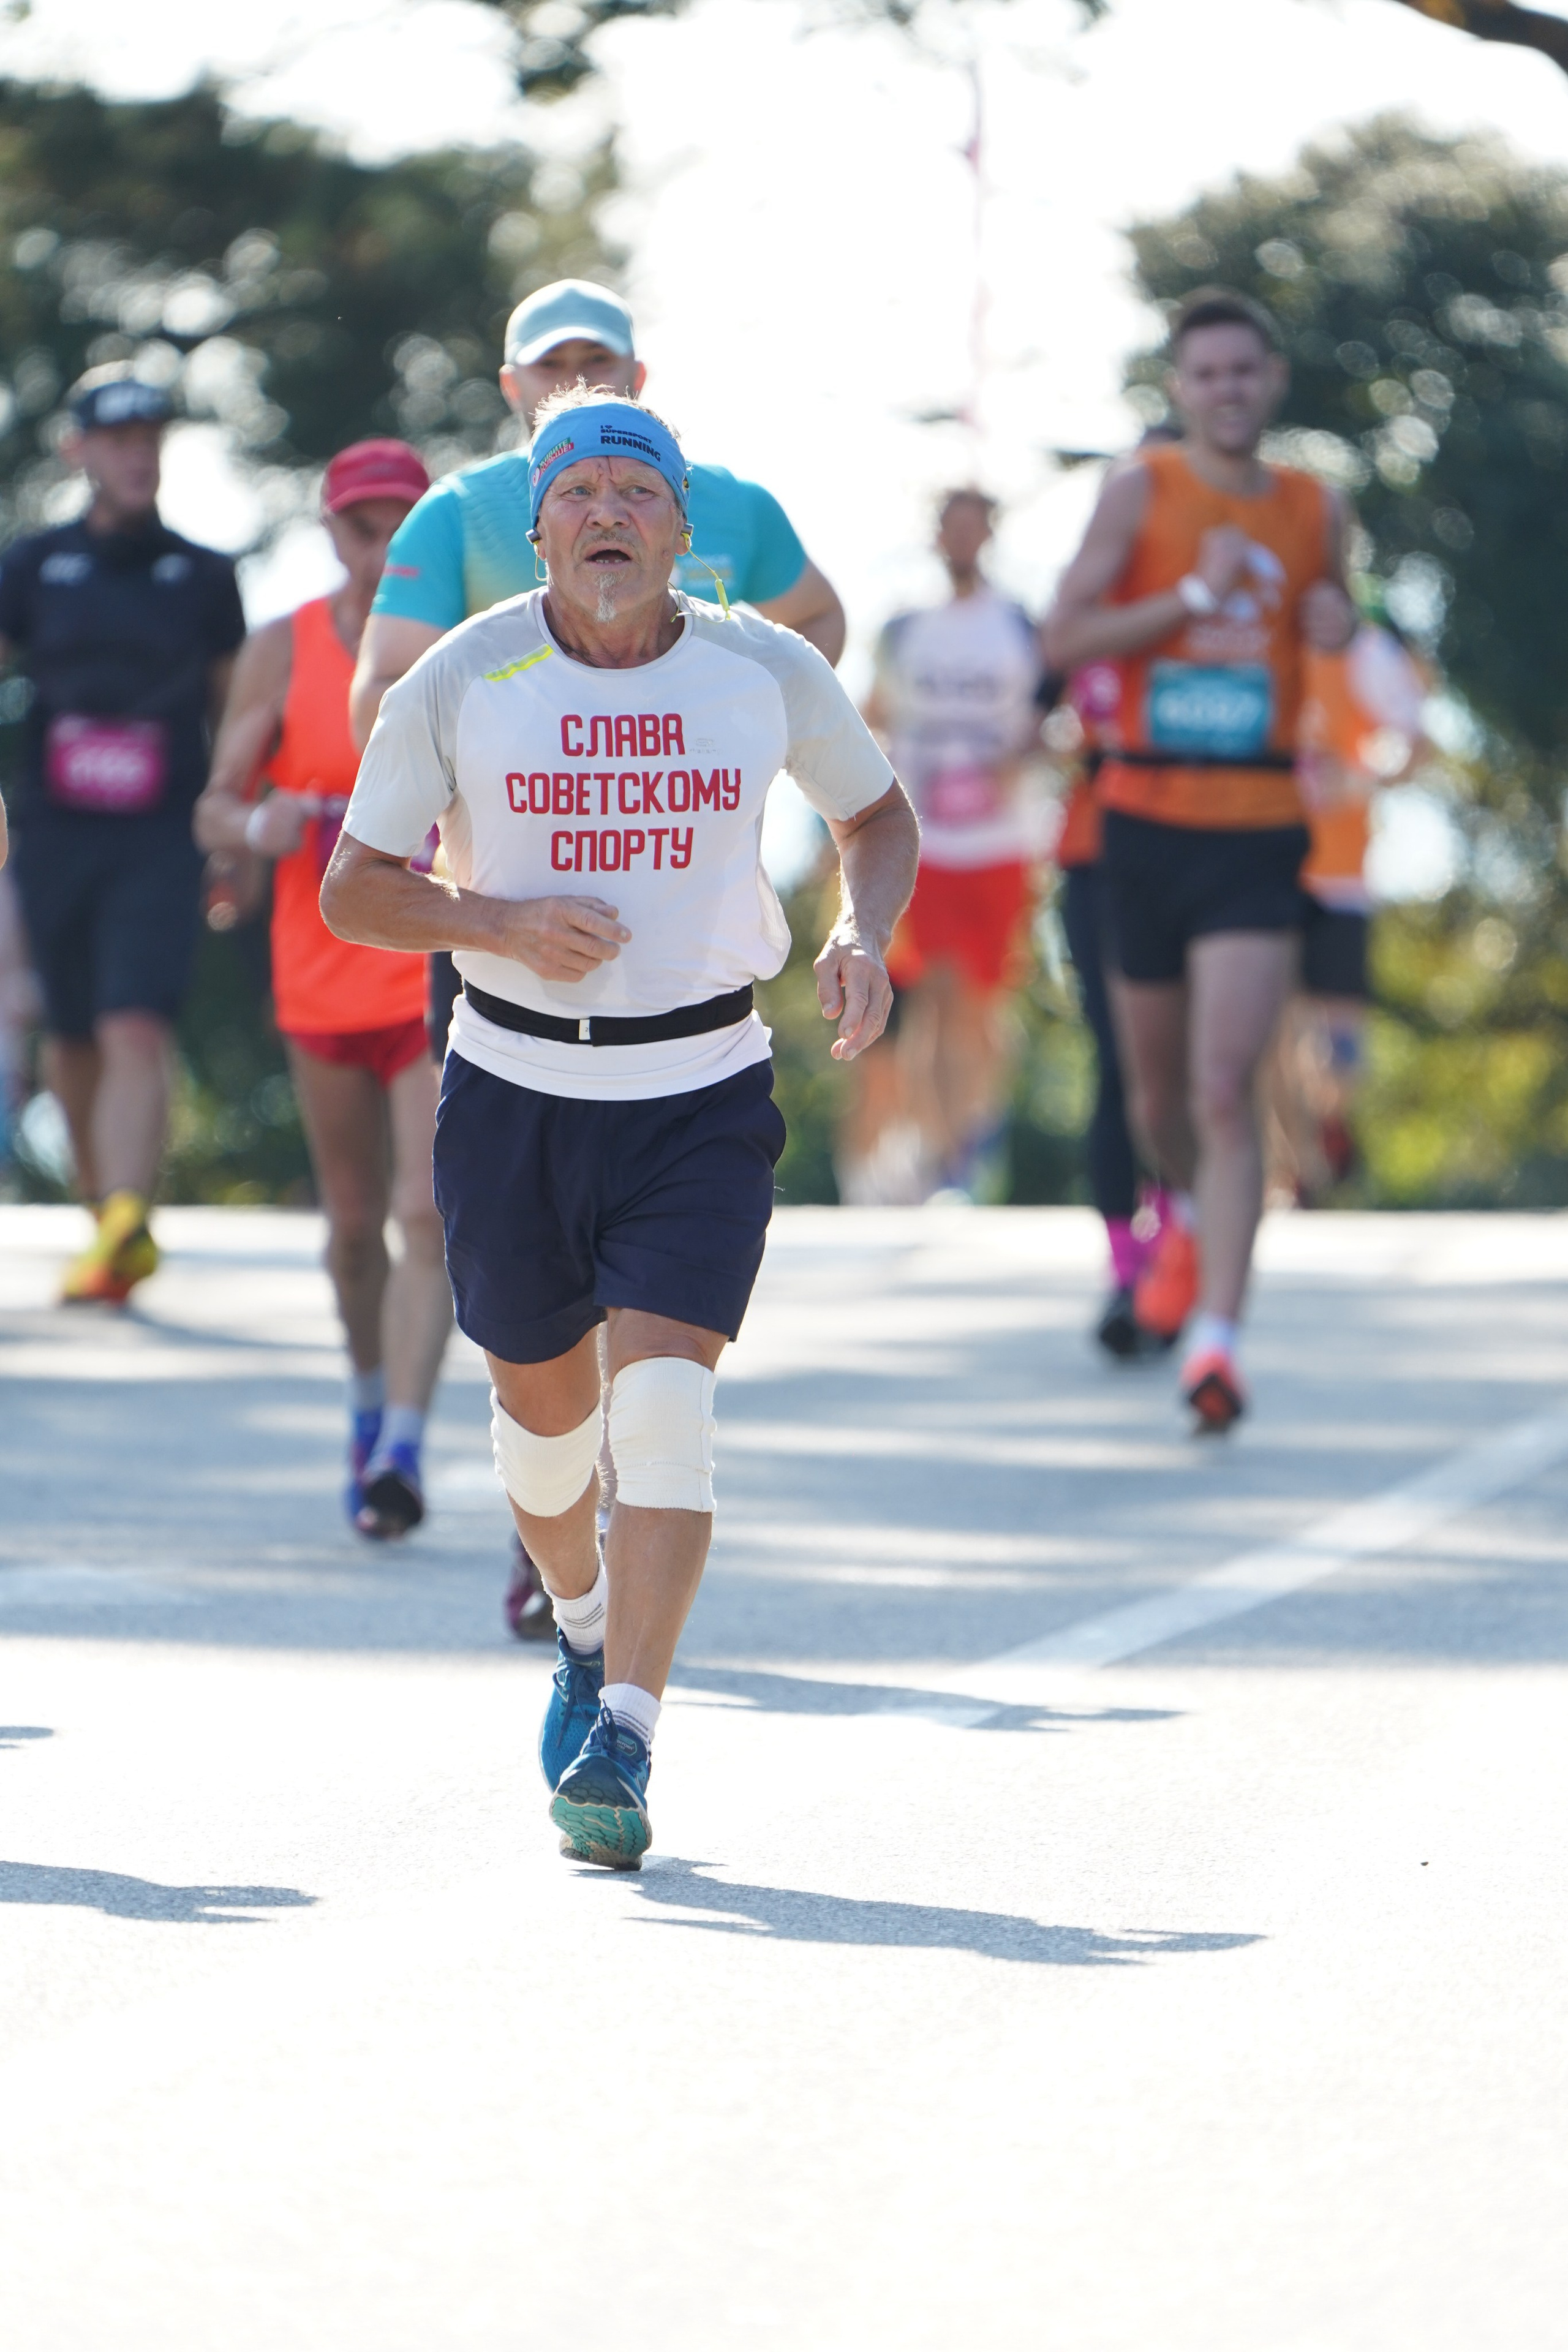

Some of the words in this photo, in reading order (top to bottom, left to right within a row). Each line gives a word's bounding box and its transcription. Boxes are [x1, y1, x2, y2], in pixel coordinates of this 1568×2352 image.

[540, 439, 568, 469] ЖИВИТЕ
[601, 429, 652, 443] SUPERSPORT
[601, 435, 661, 462] RUNNING
[560, 713, 685, 757] СЛАВА
[505, 768, 741, 815] СОВЕТСКОМУ
[551, 827, 693, 872] СПОРТУ
